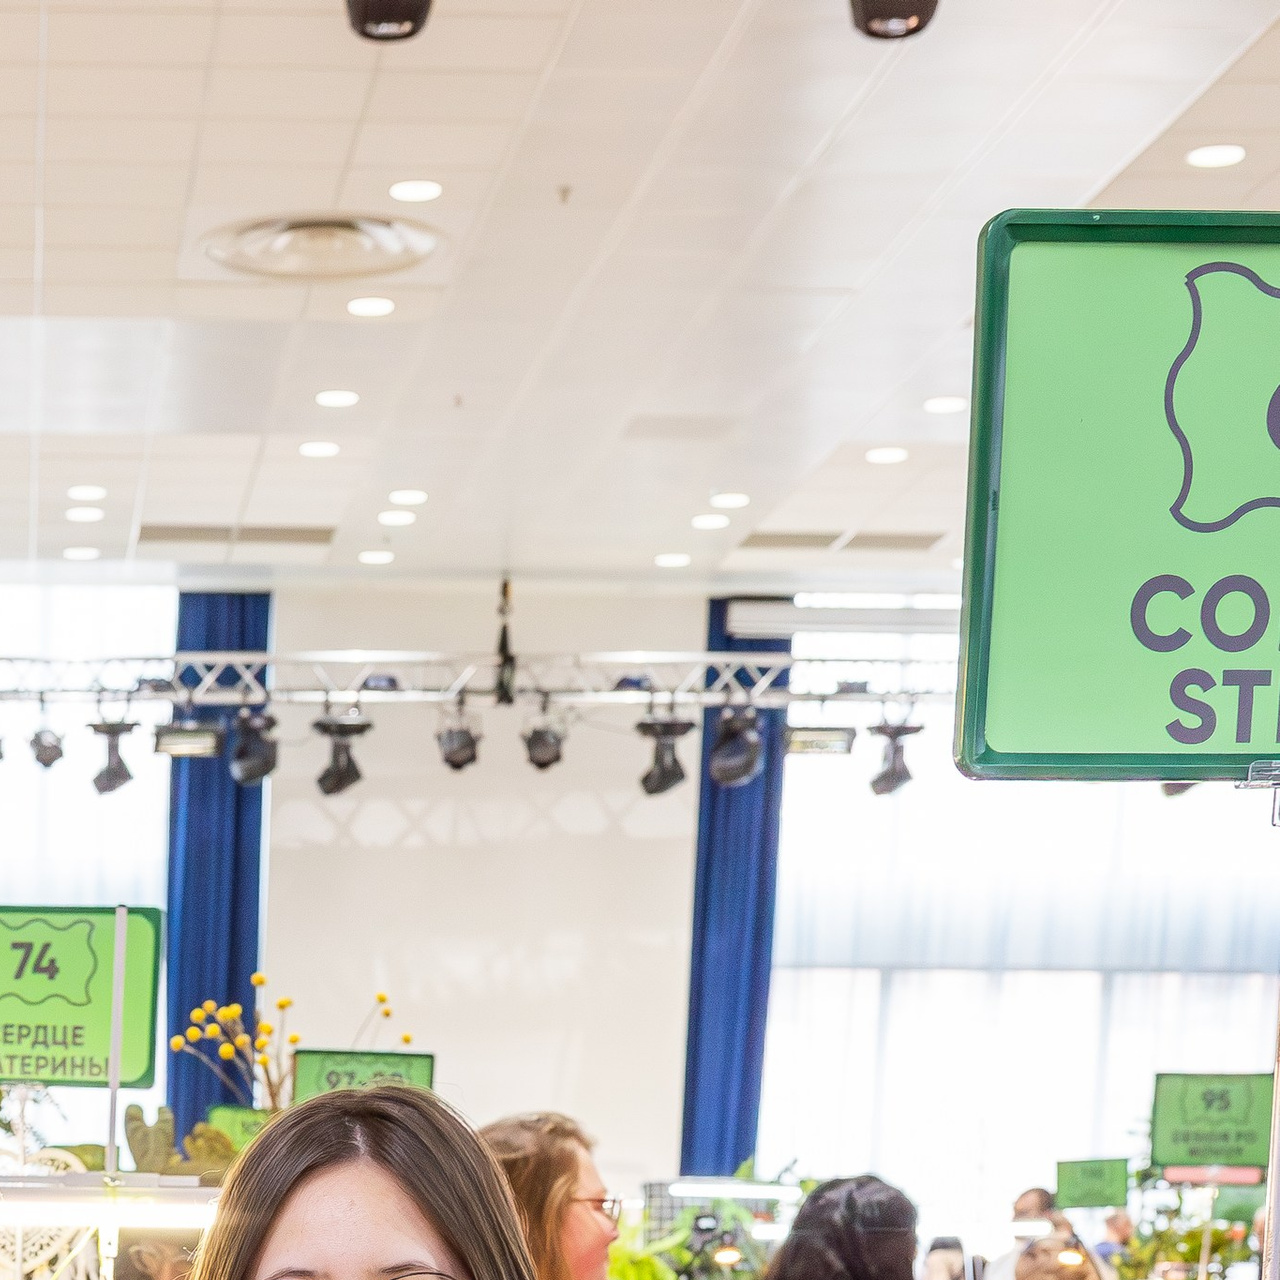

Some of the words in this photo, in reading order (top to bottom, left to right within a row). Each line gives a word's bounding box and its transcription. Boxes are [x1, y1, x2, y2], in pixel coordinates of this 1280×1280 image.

[1131, 574, 1280, 653] CO
[1165, 667, 1280, 745] ST
[11, 941, 60, 981] 74
[1201, 1089, 1232, 1111] 95
